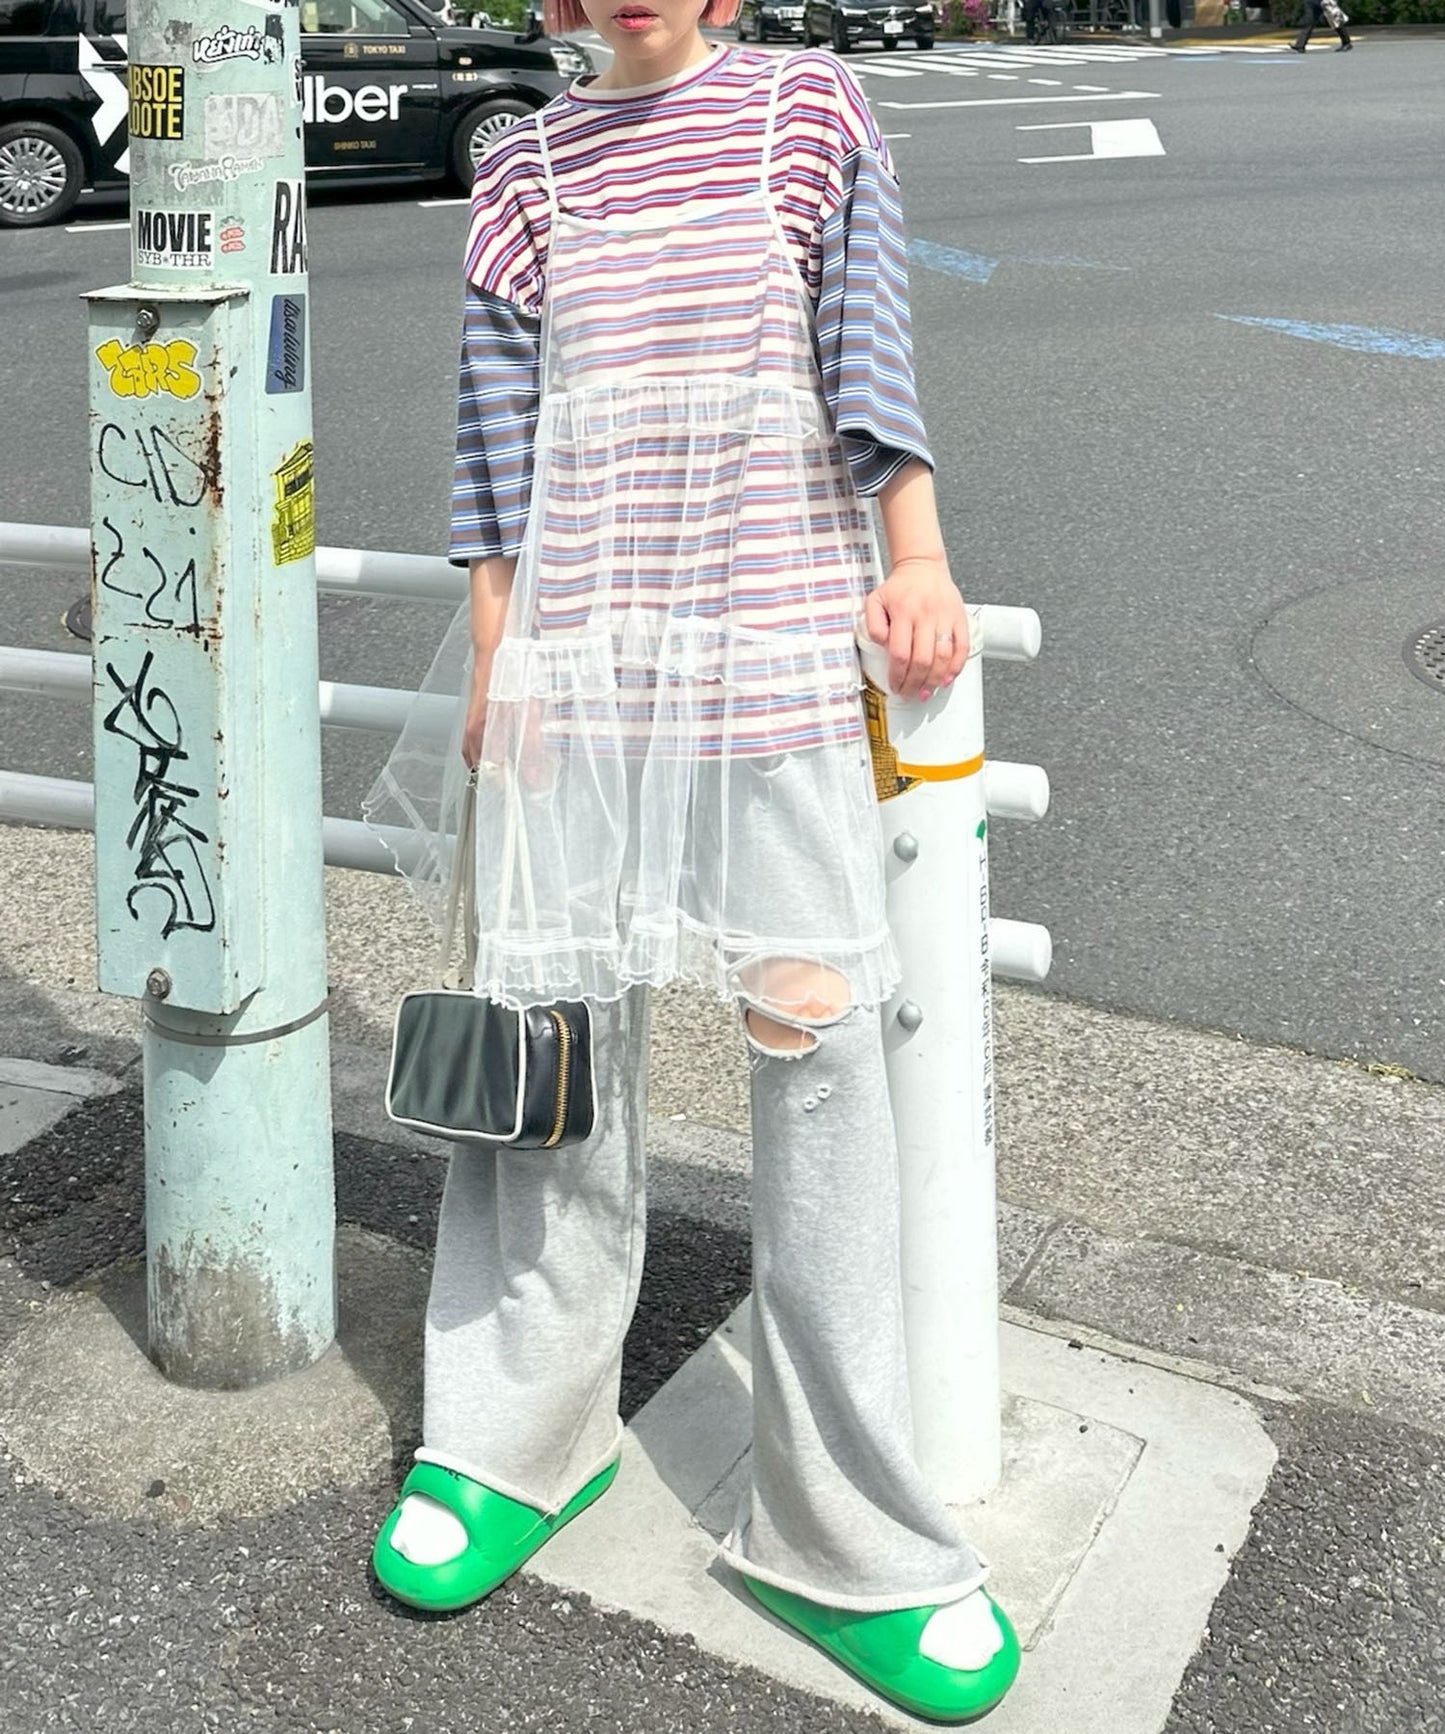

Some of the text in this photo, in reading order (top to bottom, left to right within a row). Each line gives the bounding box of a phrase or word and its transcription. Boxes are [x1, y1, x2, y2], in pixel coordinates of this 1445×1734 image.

[363, 45, 406, 54] TOKYO TAXI
[301, 75, 408, 123] ber
[138, 210, 211, 253] MOVIE
